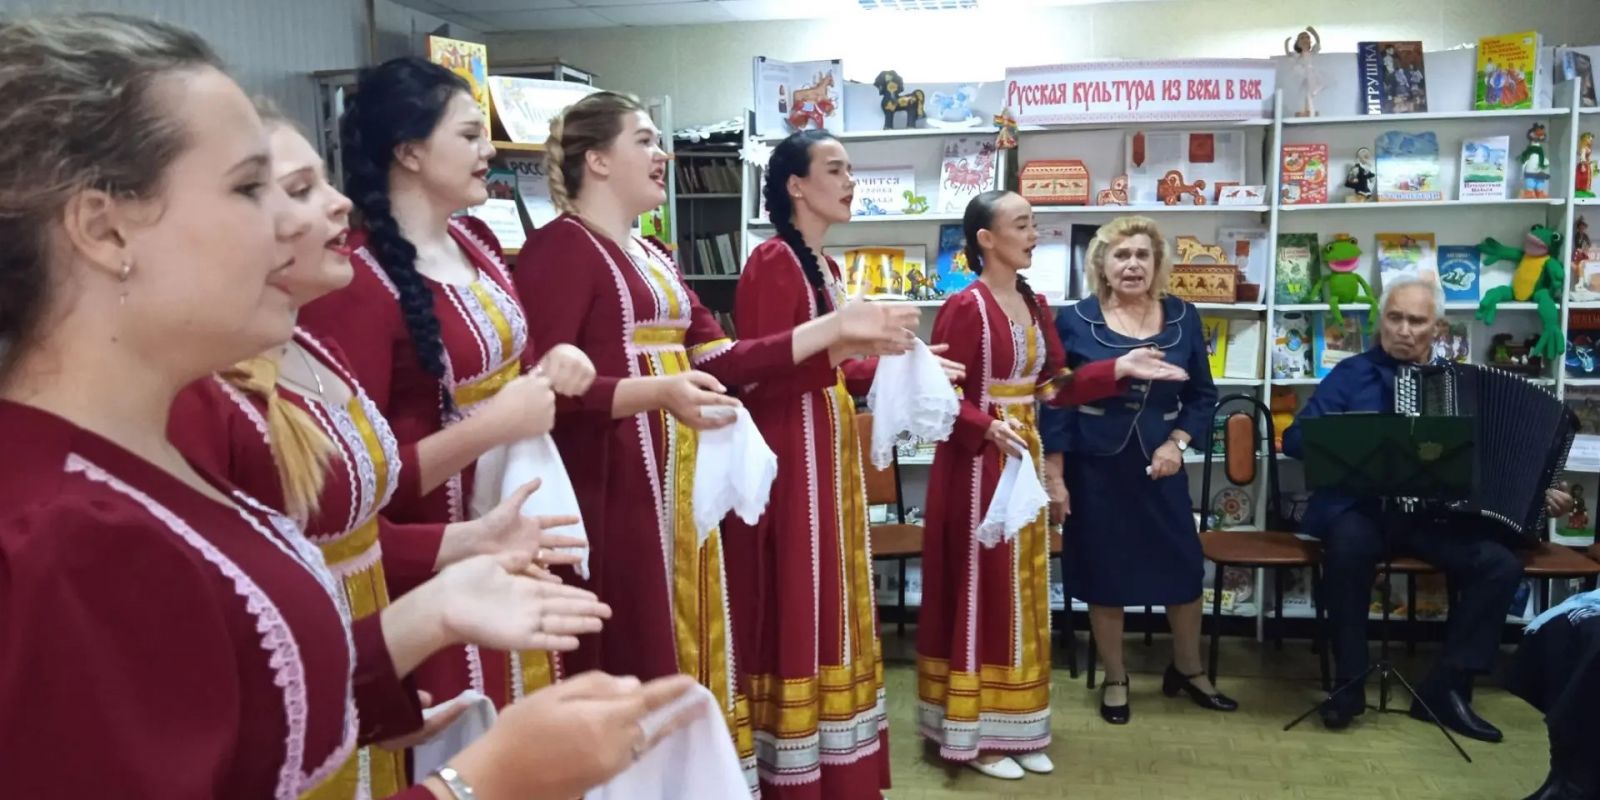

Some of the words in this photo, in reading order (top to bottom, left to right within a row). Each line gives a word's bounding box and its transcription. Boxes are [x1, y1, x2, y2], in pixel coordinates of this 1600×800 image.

[1007, 80, 1067, 114] Русская
[1072, 79, 1155, 110] культура
[1162, 79, 1181, 101] из
[1187, 78, 1220, 101] века
[1226, 79, 1235, 100] в
[1239, 78, 1262, 100] век
[1365, 43, 1382, 115] ИГРУШКА
